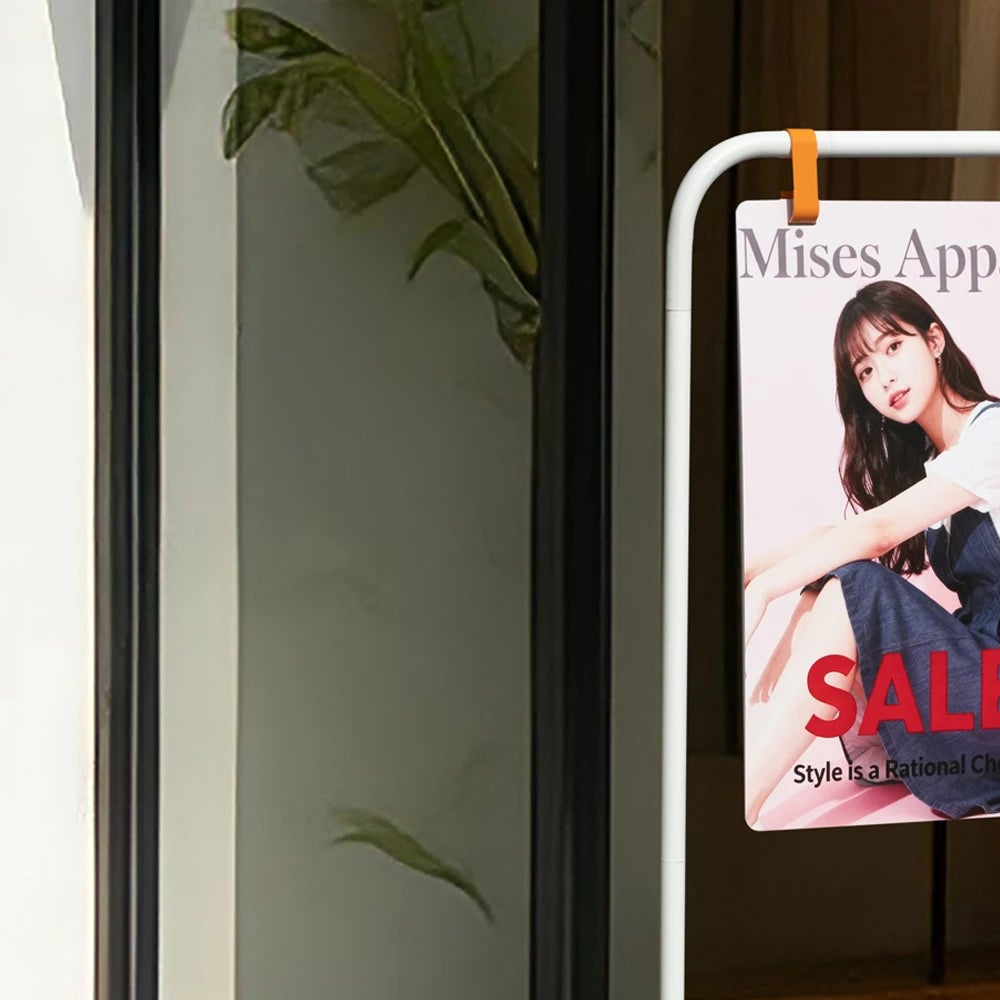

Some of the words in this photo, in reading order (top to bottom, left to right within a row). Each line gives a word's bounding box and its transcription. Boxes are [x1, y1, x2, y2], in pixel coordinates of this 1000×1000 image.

[738, 228, 881, 279] Mises
[793, 760, 843, 788] Style
[849, 760, 863, 780] is
[870, 764, 880, 779] a
[885, 756, 966, 780] Rational
